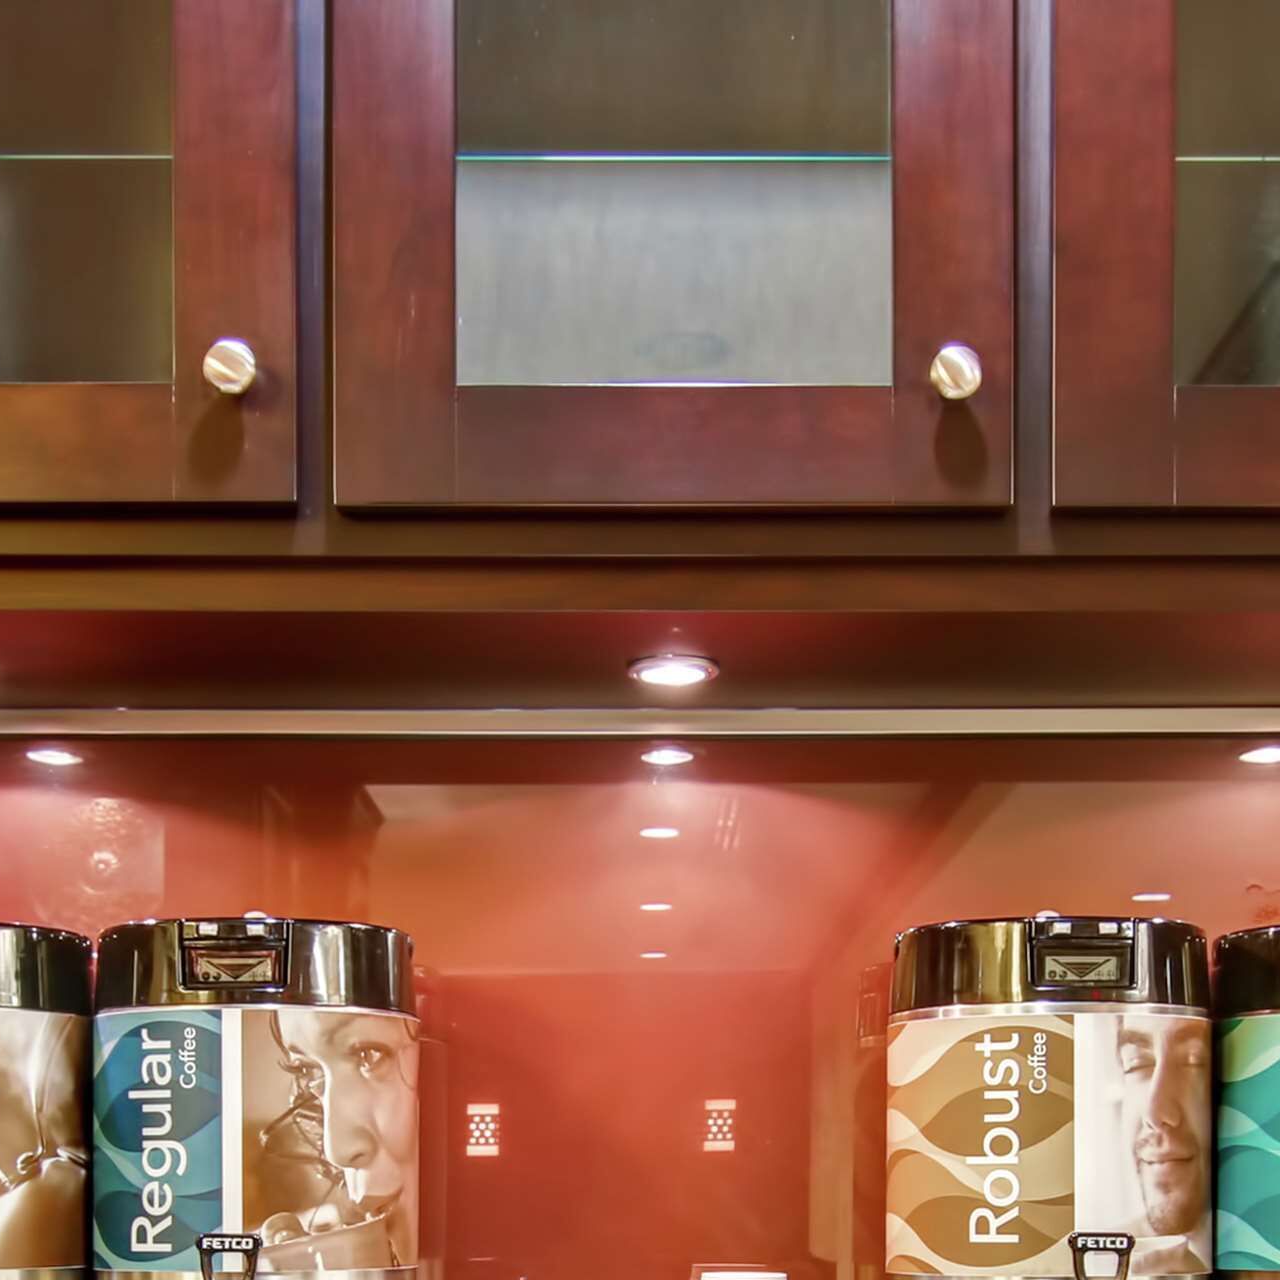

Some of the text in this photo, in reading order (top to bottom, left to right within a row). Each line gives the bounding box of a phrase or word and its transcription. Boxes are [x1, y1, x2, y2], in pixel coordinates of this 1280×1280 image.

[179, 1026, 196, 1089] Coffee
[1028, 1032, 1047, 1094] Coffee
[128, 1028, 187, 1252] Regular
[966, 1033, 1020, 1243] Robust
[202, 1237, 254, 1249] FETCO
[1077, 1236, 1129, 1248] FETCO
